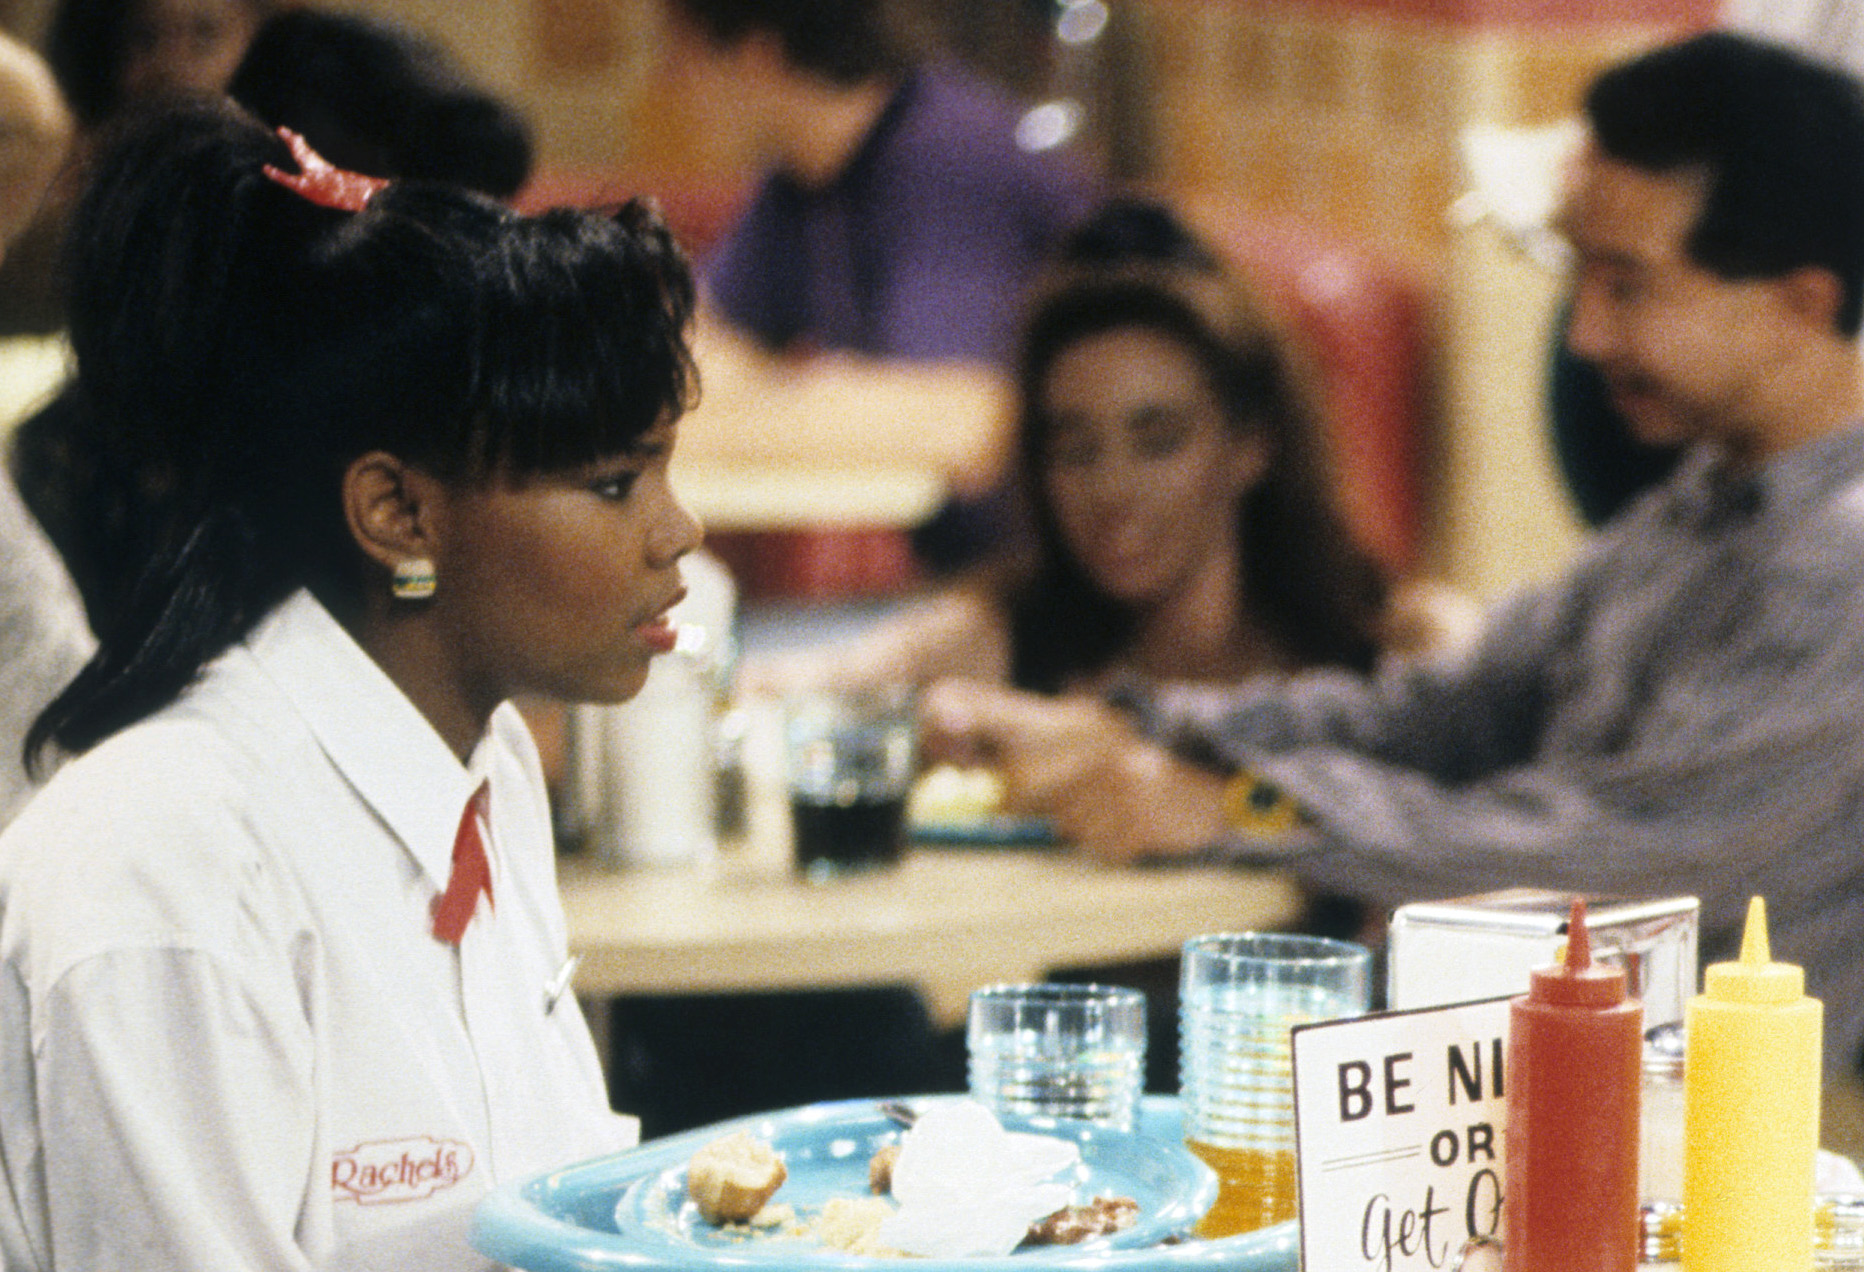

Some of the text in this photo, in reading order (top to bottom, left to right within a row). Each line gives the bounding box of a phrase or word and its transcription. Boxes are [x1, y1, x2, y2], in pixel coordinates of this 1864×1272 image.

[1338, 1036, 1504, 1123] BE NI
[1430, 1122, 1495, 1167] OR
[1466, 1168, 1505, 1237] O
